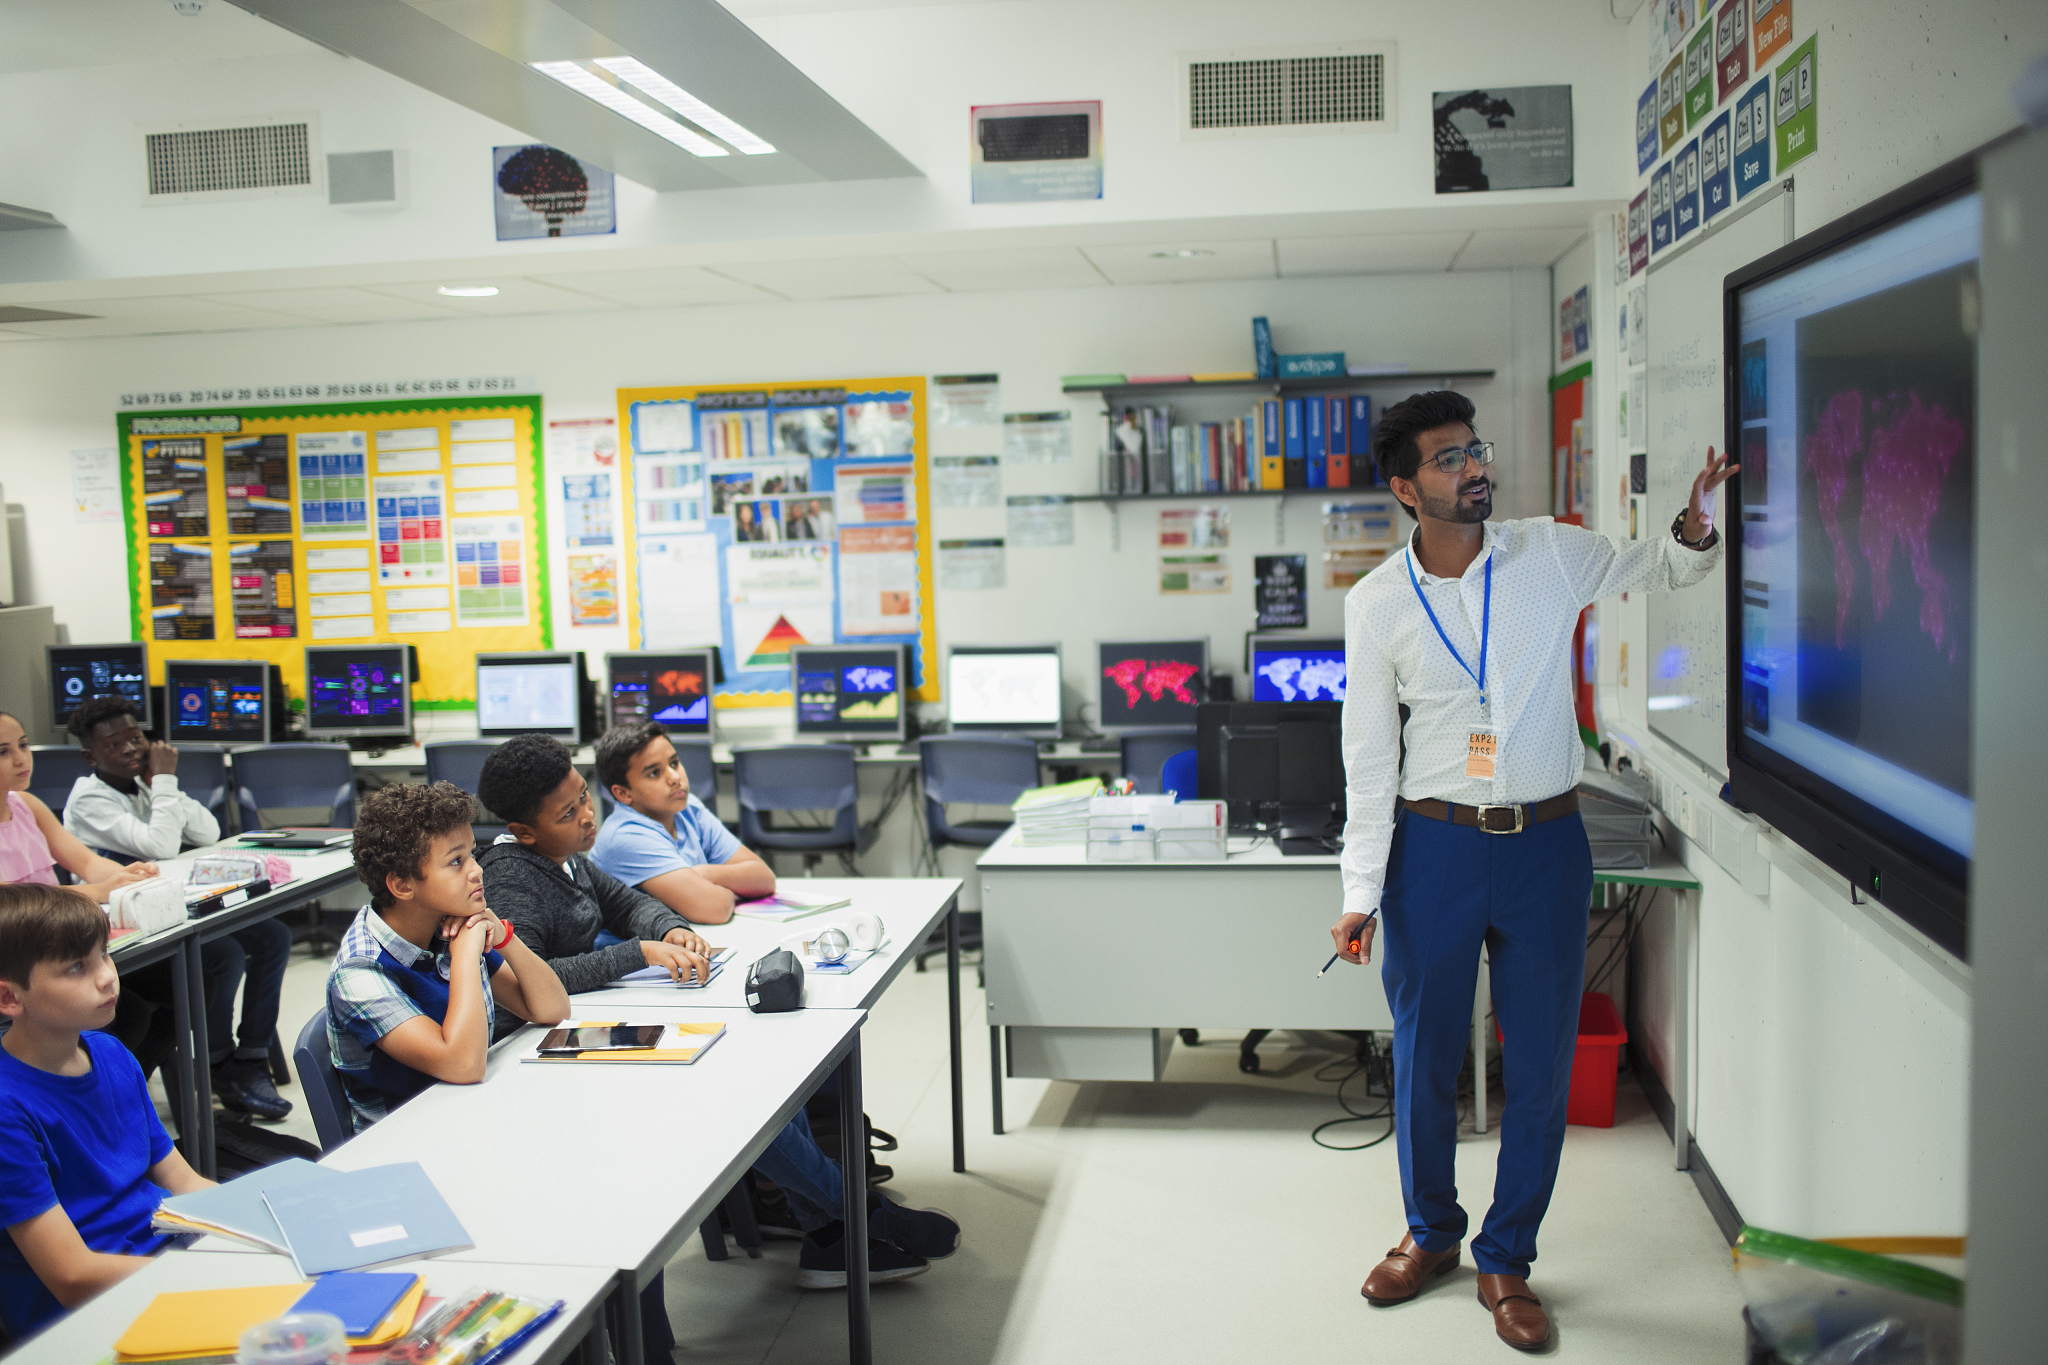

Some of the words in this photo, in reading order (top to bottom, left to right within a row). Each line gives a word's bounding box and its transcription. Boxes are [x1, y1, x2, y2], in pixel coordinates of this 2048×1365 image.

[1720, 22, 1731, 45] Ctrl
[1758, 28, 1774, 53] New
[1773, 13, 1788, 39] File
[1726, 59, 1741, 84] Undo
[1779, 80, 1792, 106] Ctrl
[1802, 69, 1808, 90] P
[1738, 120, 1750, 138] Ctrl
[1757, 106, 1762, 125] S
[1787, 125, 1806, 153] Print
[1704, 148, 1714, 166] Ctrl
[1744, 160, 1760, 182] Save
[1712, 185, 1722, 204] Cut
[1679, 206, 1694, 226] Paste
[1656, 223, 1668, 242] Copy
[160, 446, 202, 458] PYTHON
[1468, 746, 1490, 756] PASS
